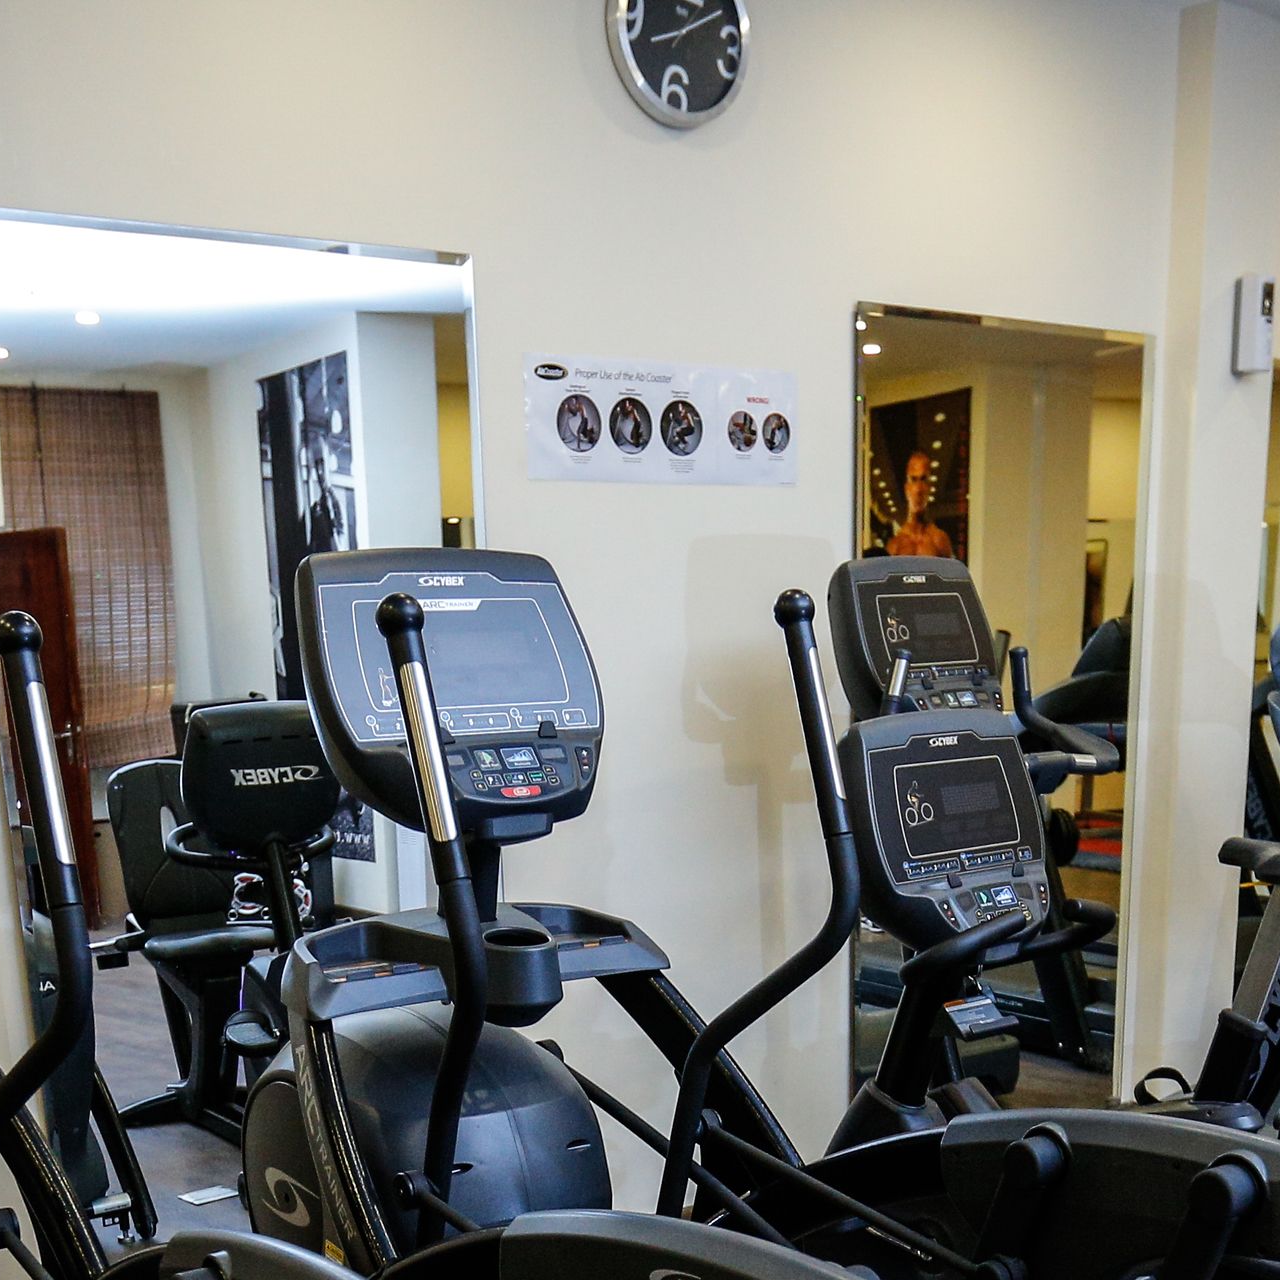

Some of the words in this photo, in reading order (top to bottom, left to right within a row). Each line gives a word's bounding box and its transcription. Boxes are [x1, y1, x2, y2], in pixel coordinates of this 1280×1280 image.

[716, 24, 740, 80] 3
[661, 64, 689, 113] 6
[575, 368, 598, 381] Proper
[600, 370, 613, 380] Use
[614, 371, 622, 380] of
[622, 372, 634, 380] the
[635, 373, 645, 381] Ab
[646, 373, 672, 384] Coaster
[433, 576, 464, 586] CYBEX
[422, 601, 446, 609] ARC
[295, 1043, 316, 1137] ARC
[317, 1133, 357, 1241] TRAINER
